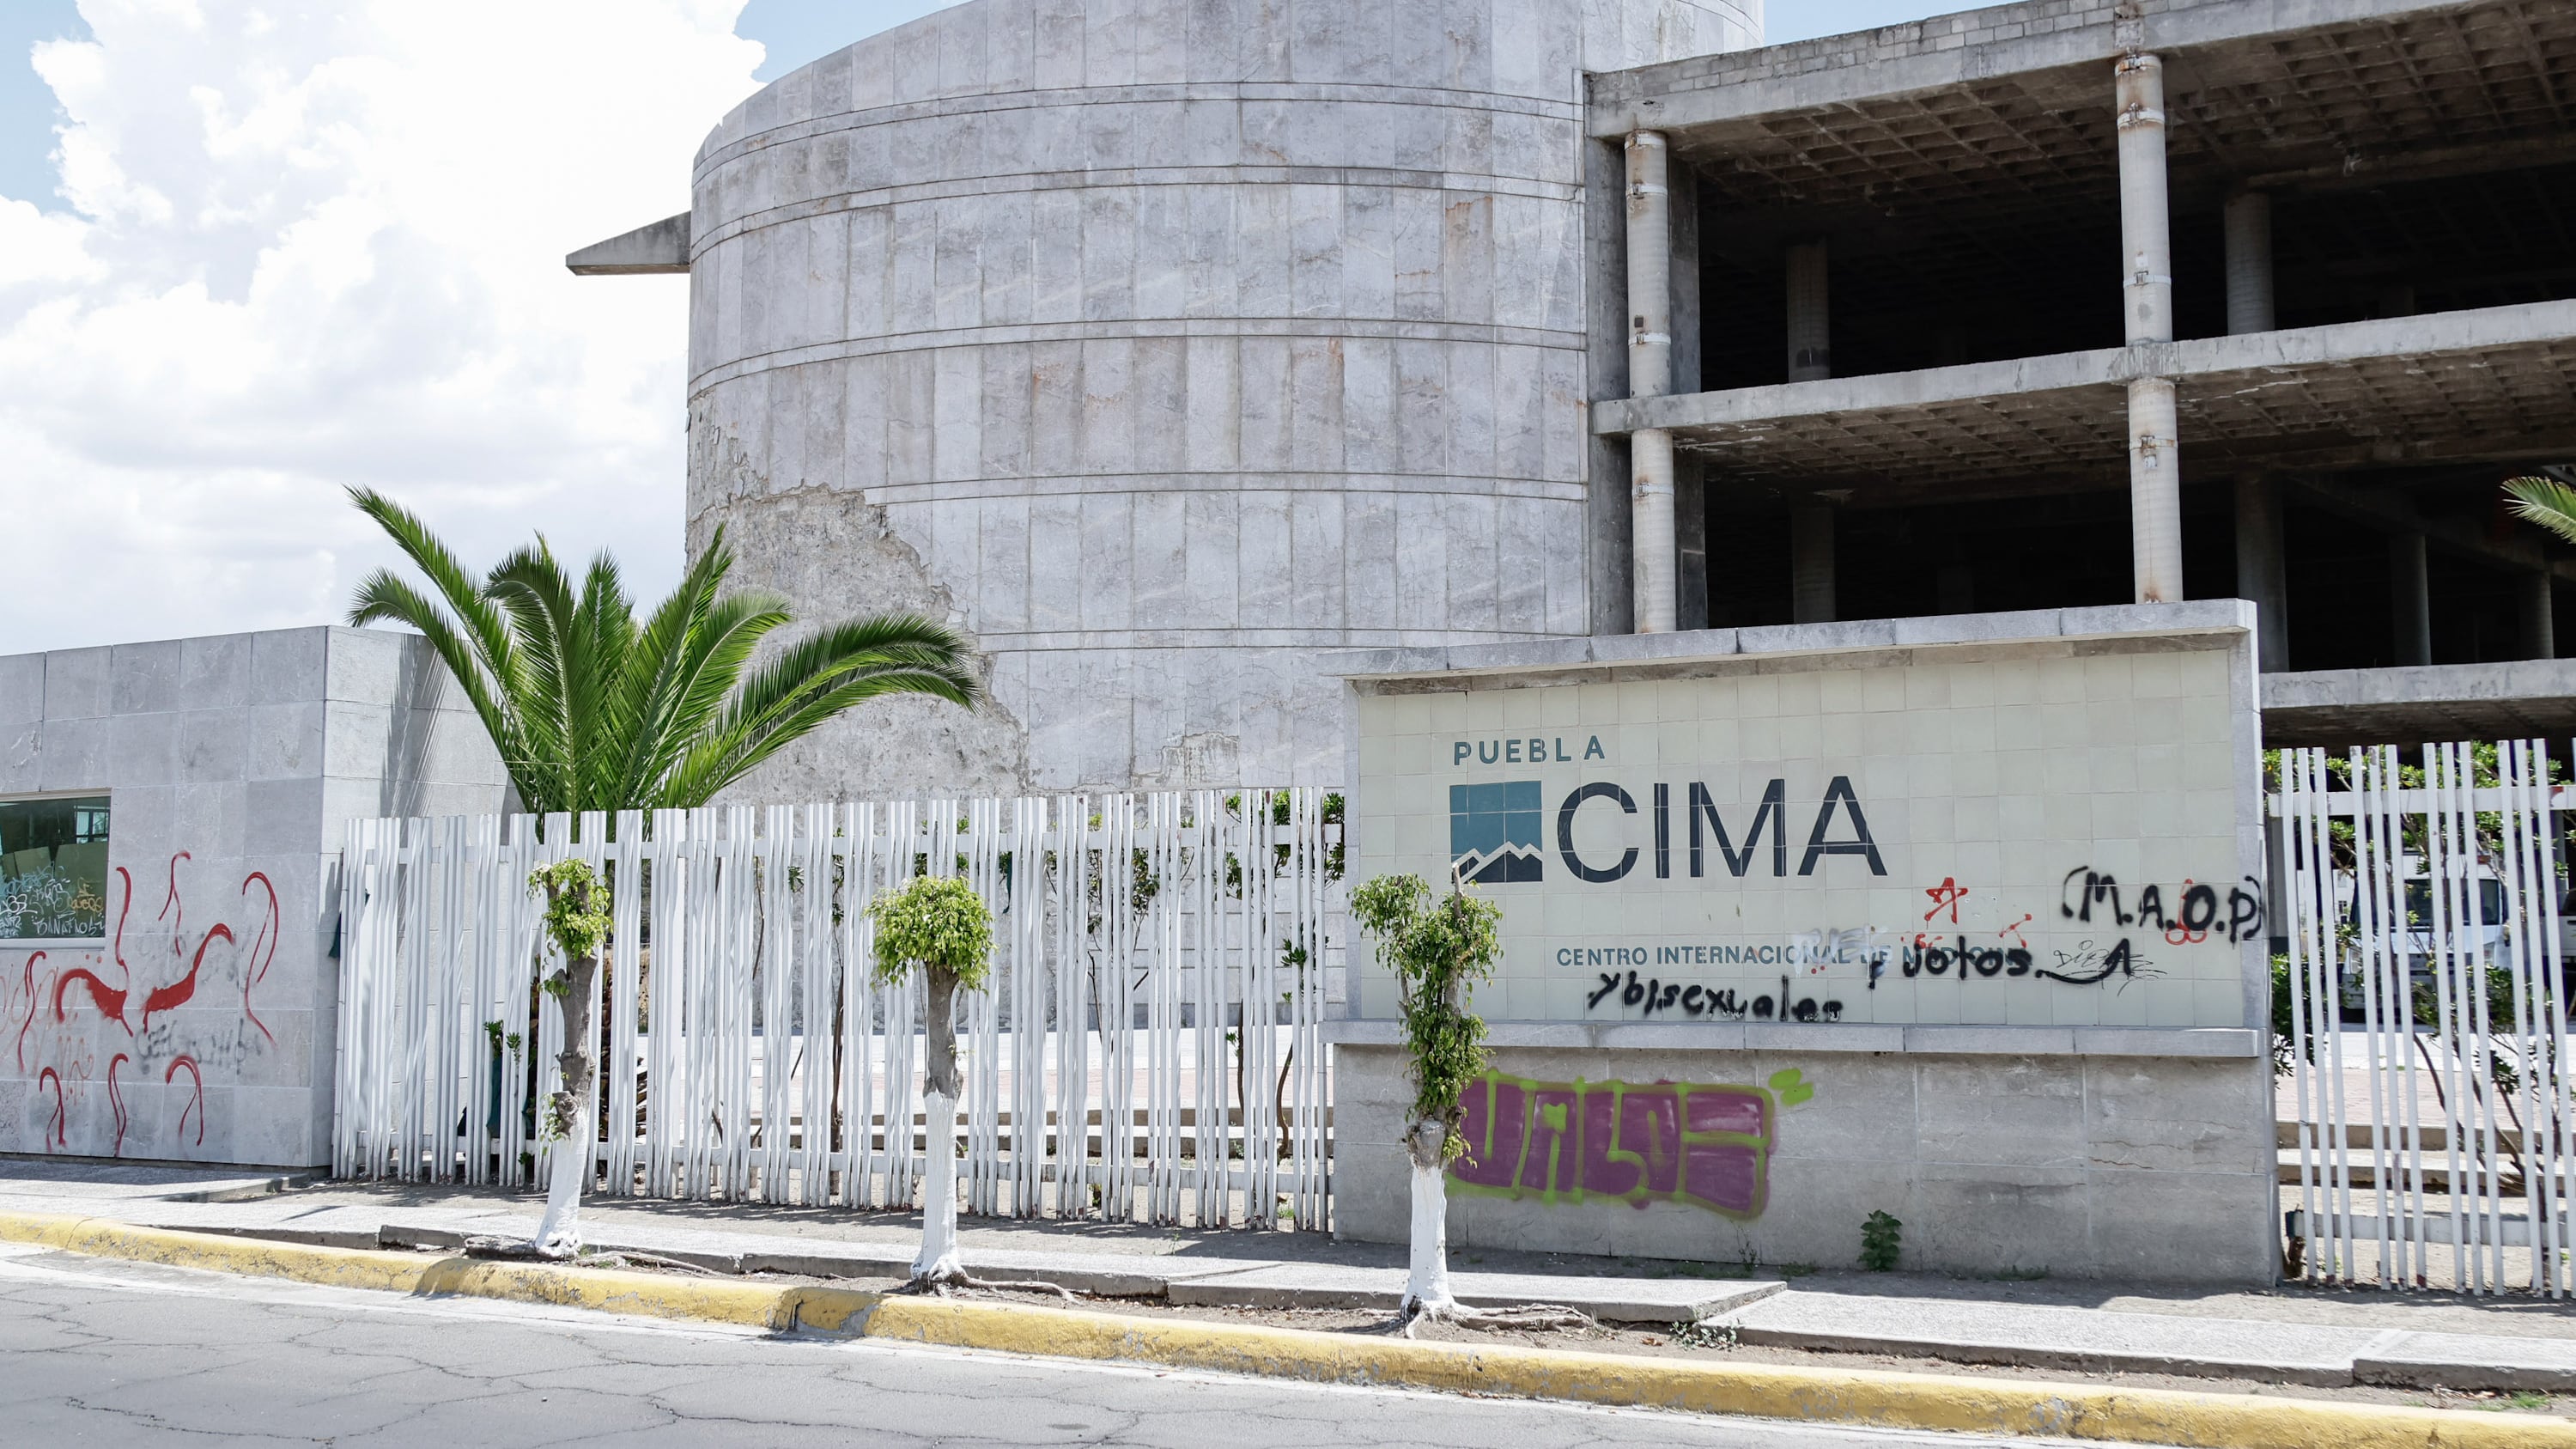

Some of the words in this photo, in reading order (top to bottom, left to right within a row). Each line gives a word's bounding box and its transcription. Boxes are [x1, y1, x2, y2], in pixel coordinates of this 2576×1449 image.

[1454, 734, 1606, 766] PUEBLA
[1557, 776, 1888, 884] CIMA
[1556, 947, 1648, 966] CENTRO
